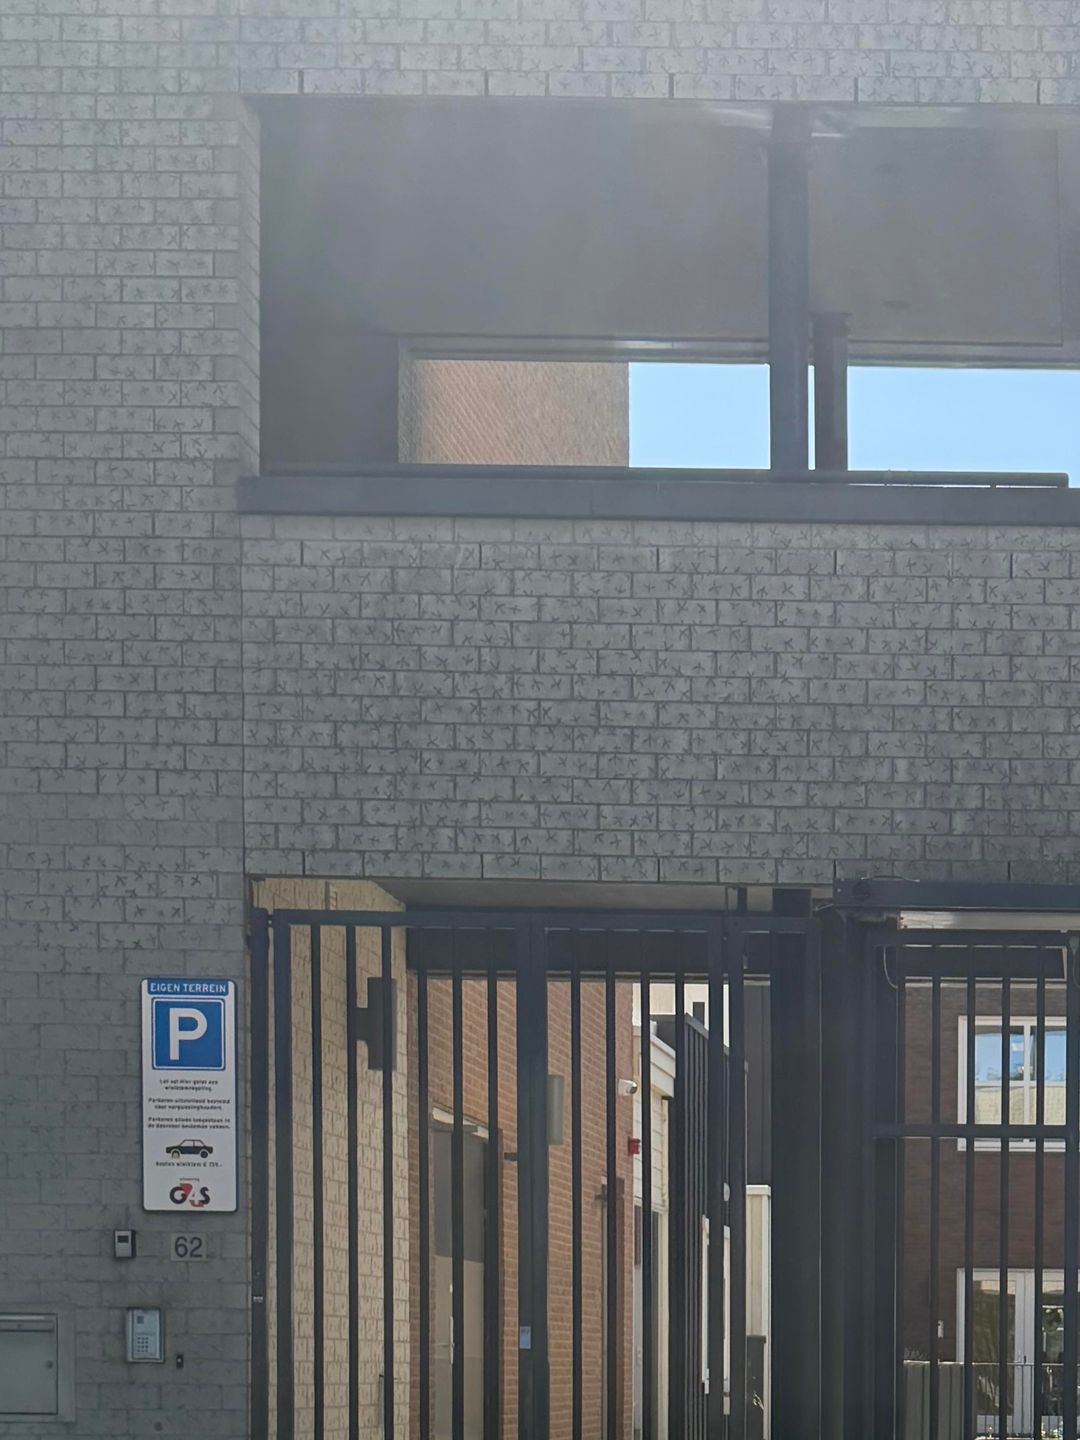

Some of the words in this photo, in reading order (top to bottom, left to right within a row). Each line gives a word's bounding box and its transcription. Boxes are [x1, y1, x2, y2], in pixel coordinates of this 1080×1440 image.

[150, 983, 180, 992] EIGEN
[183, 983, 226, 993] TERREIN
[169, 1007, 208, 1061] P
[169, 1183, 210, 1208] G4S
[175, 1236, 202, 1258] 62
